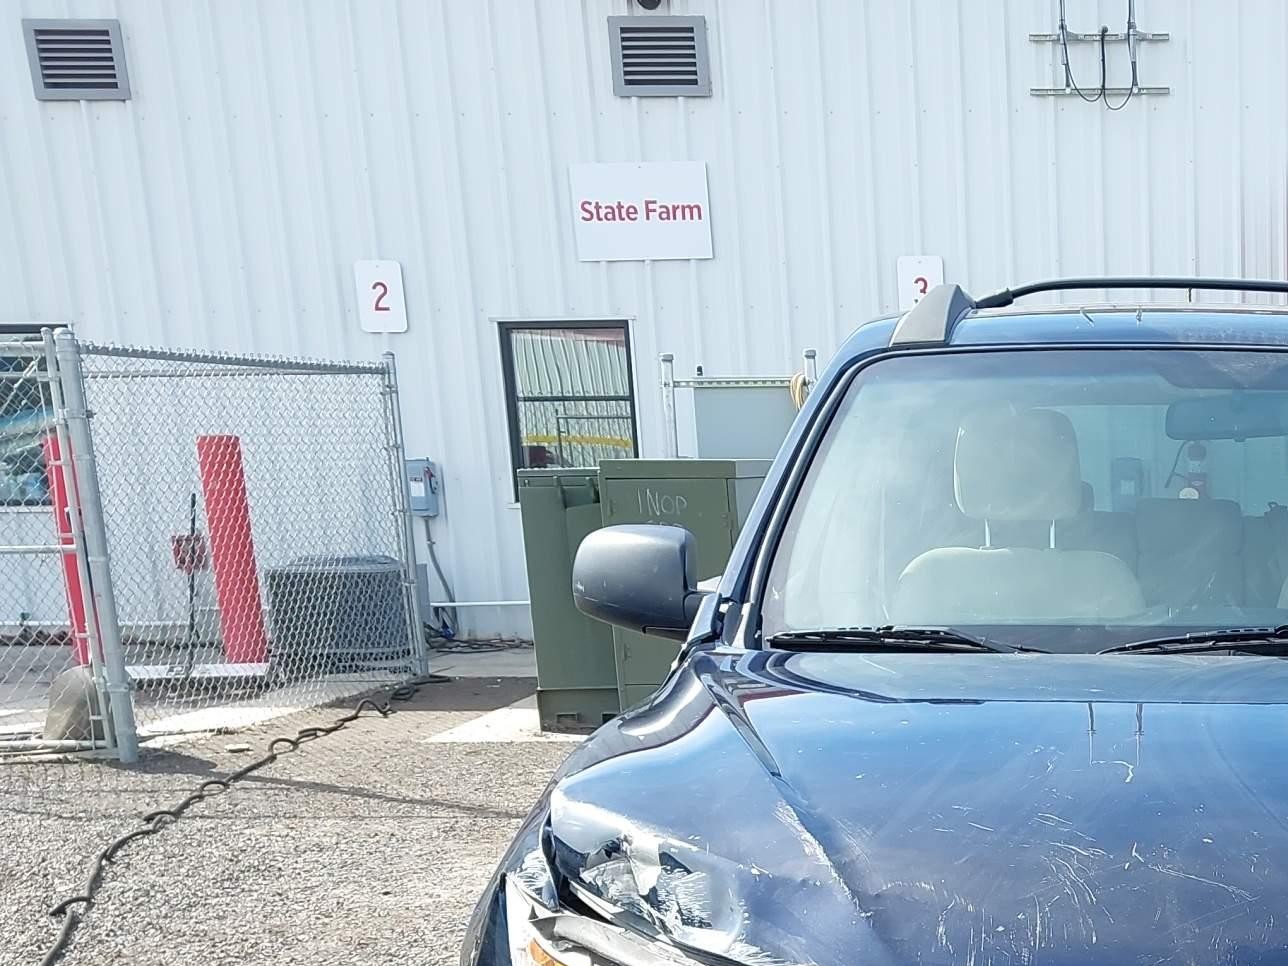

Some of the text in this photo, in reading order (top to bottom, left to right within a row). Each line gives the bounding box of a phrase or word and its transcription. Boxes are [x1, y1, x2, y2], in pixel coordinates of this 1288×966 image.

[580, 199, 703, 222] State Farm
[371, 281, 391, 312] 2
[637, 487, 688, 517] INOP
